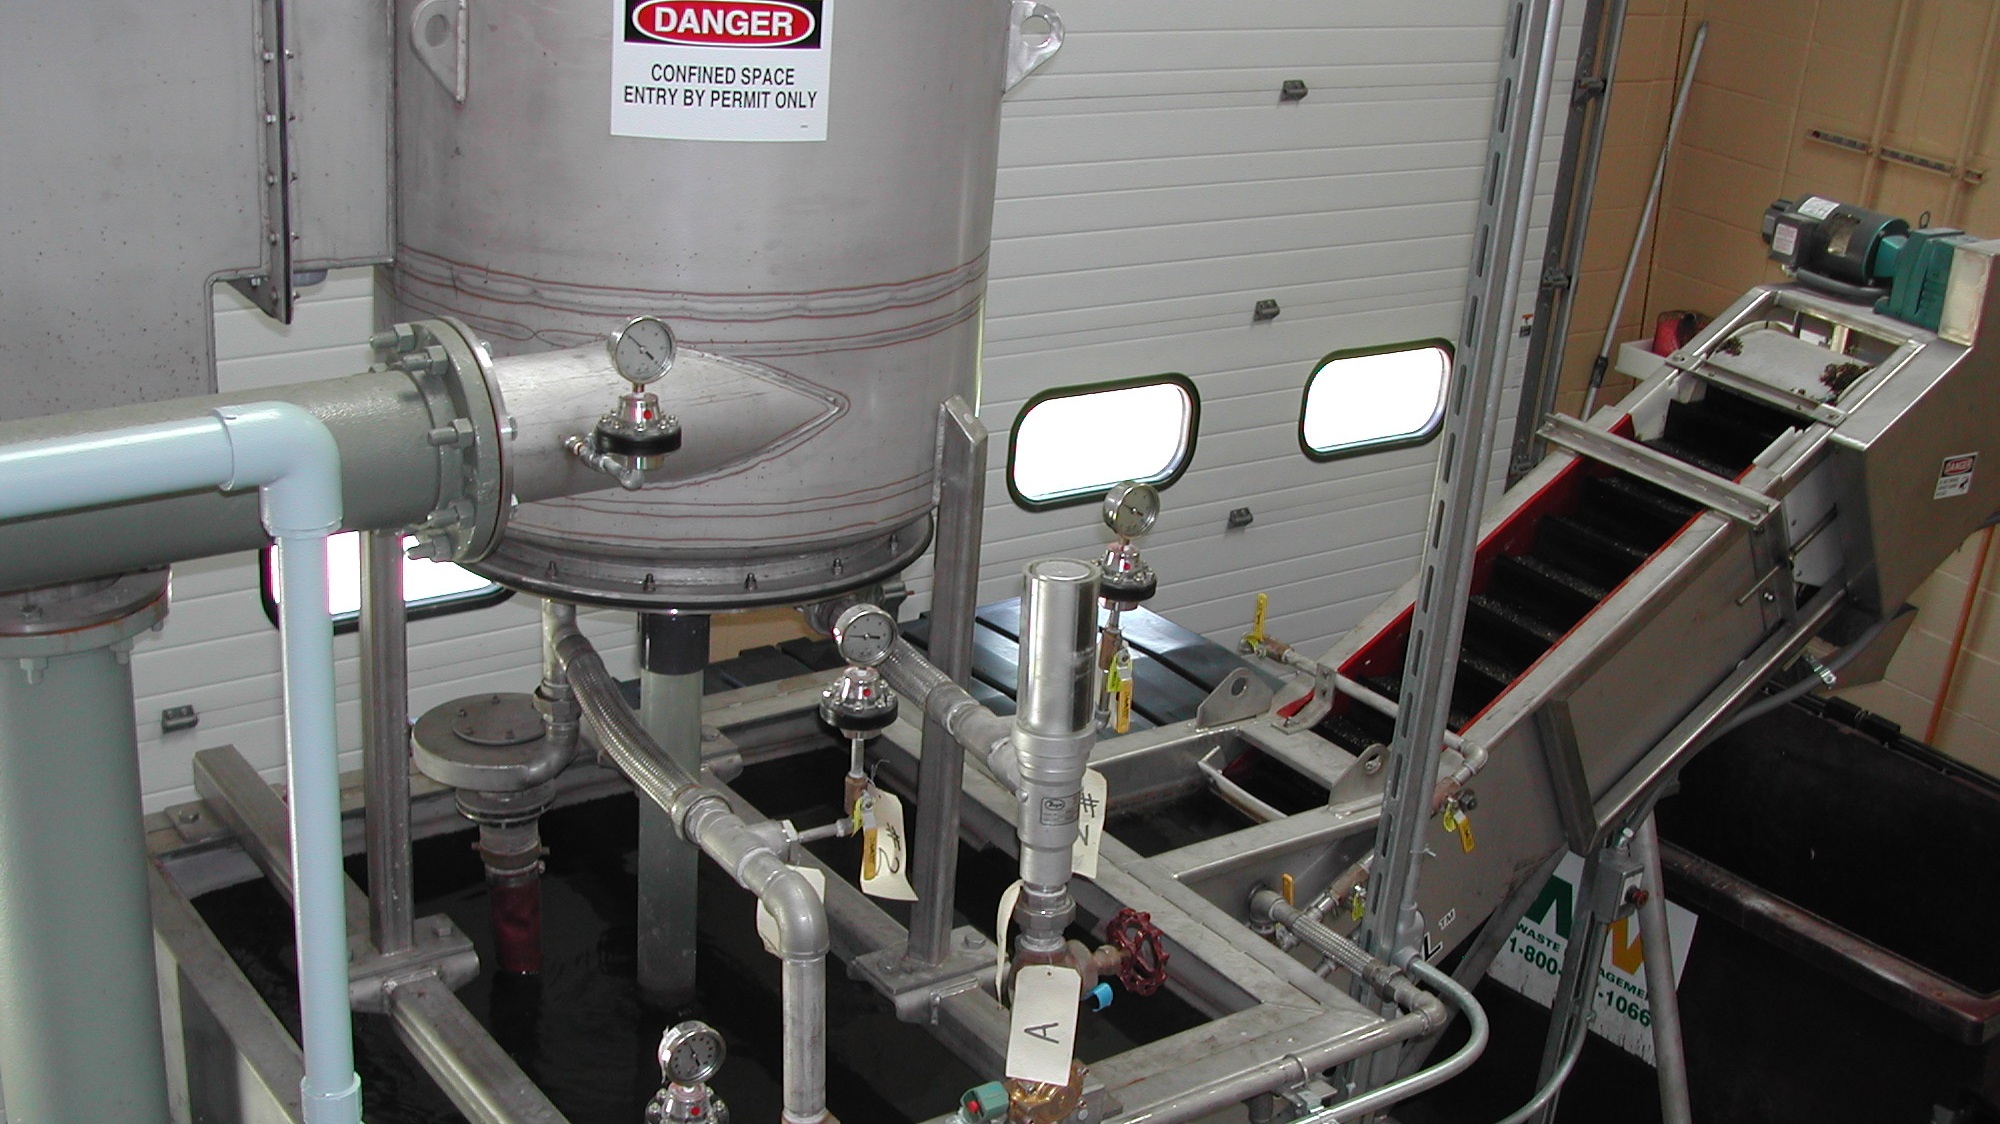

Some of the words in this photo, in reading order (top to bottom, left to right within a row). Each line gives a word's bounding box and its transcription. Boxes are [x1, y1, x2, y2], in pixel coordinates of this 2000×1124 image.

[654, 6, 794, 37] DANGER
[651, 63, 736, 85] CONFINED
[741, 67, 795, 86] SPACE
[624, 86, 678, 106] ENTRY
[684, 89, 706, 107] BY
[710, 90, 771, 109] PERMIT
[775, 91, 818, 109] ONLY
[1516, 923, 1561, 953] WASTE
[1024, 1021, 1059, 1044] A
